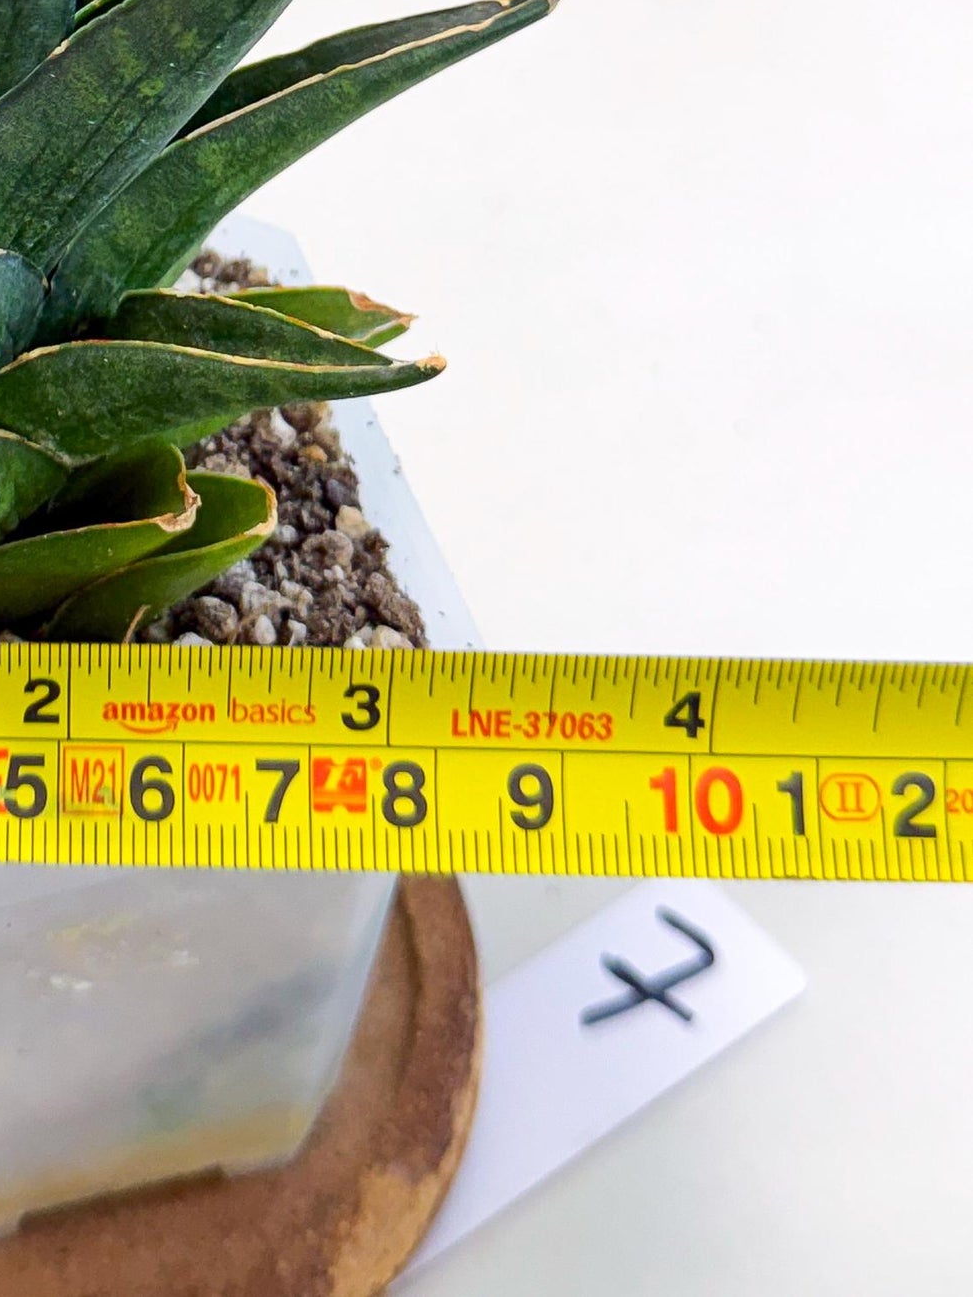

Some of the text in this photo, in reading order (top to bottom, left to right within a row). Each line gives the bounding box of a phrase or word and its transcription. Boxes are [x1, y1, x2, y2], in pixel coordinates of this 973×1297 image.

[24, 678, 61, 724] 2
[103, 698, 316, 724] amazon basics
[341, 684, 381, 730] 3
[451, 709, 613, 740] LNE-37063
[664, 691, 705, 738] 4
[5, 754, 47, 819] 5
[71, 758, 116, 804] M21
[129, 755, 175, 821] 6
[188, 763, 241, 802] 0071
[255, 759, 300, 823] 7
[382, 760, 427, 827] 8
[507, 763, 554, 830] 9
[649, 766, 744, 836] 10
